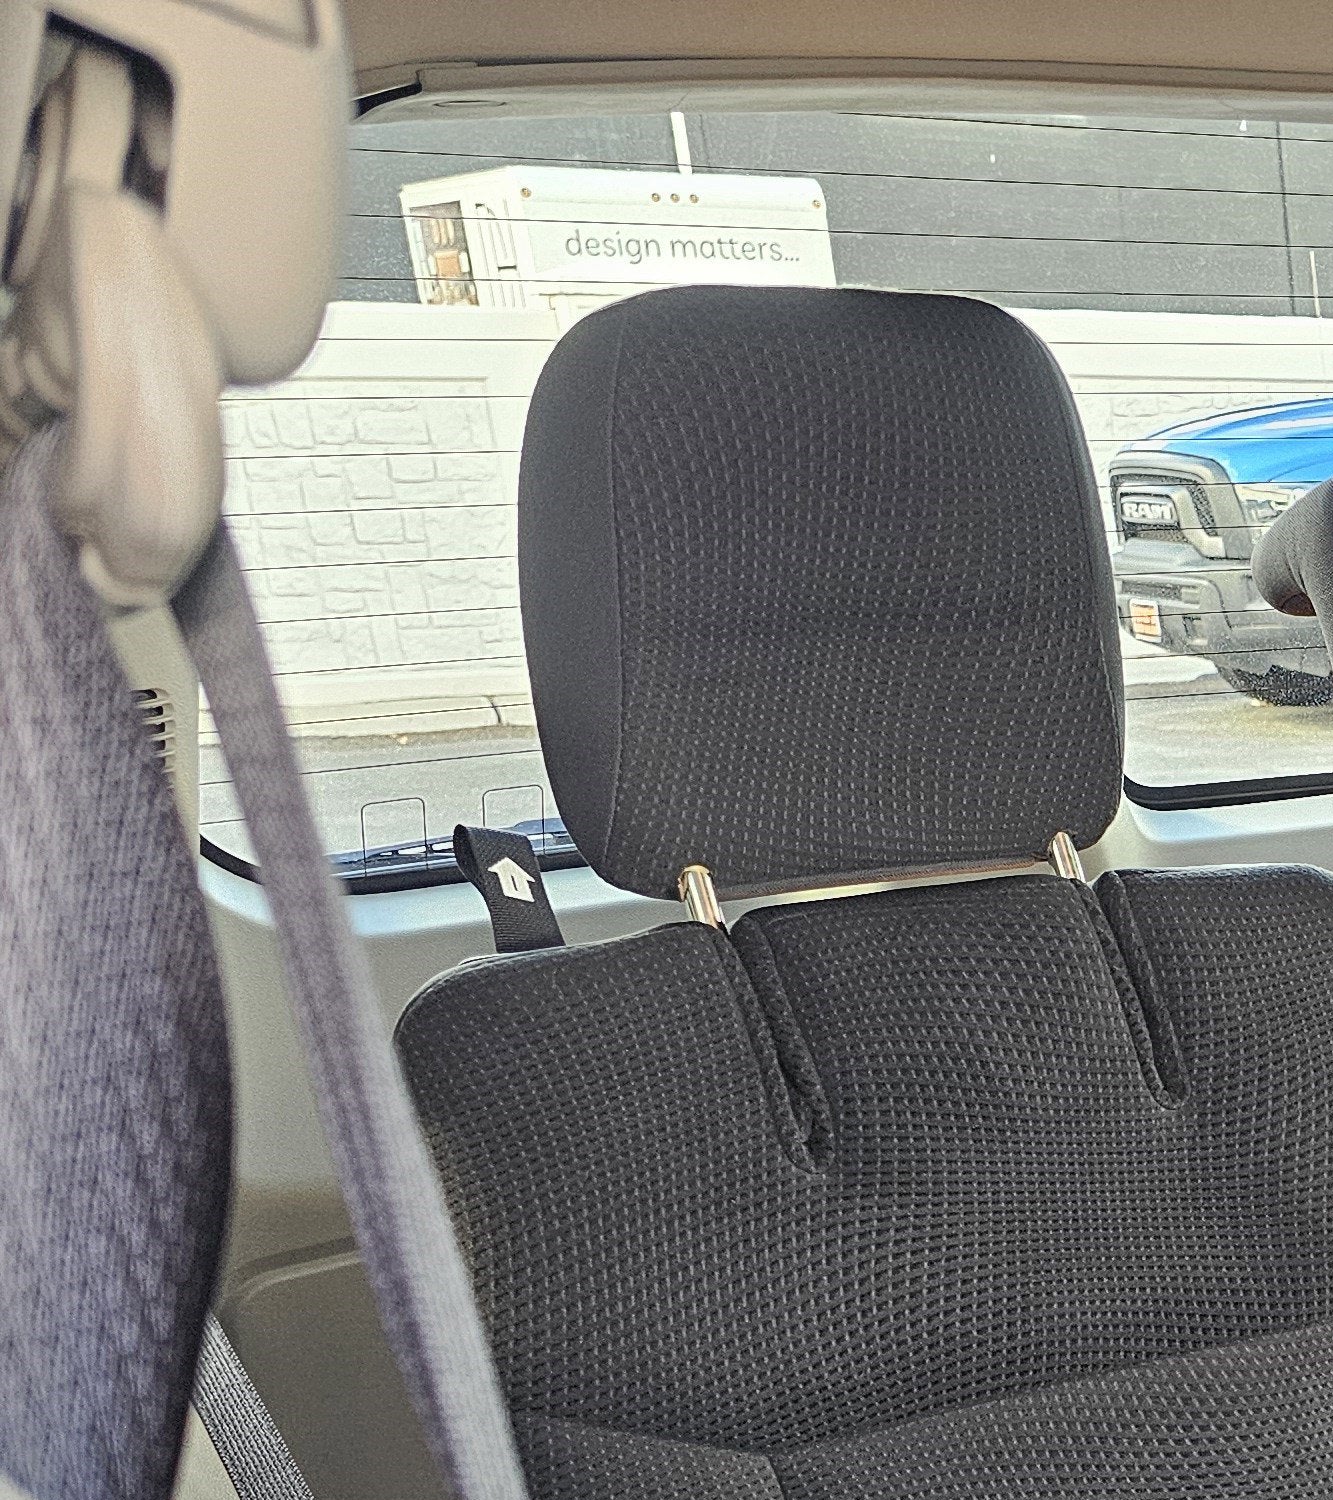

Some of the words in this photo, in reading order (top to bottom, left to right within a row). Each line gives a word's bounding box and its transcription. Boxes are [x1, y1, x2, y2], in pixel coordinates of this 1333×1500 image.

[565, 228, 661, 264] design
[670, 238, 800, 261] matters...
[1121, 502, 1172, 520] RAM
